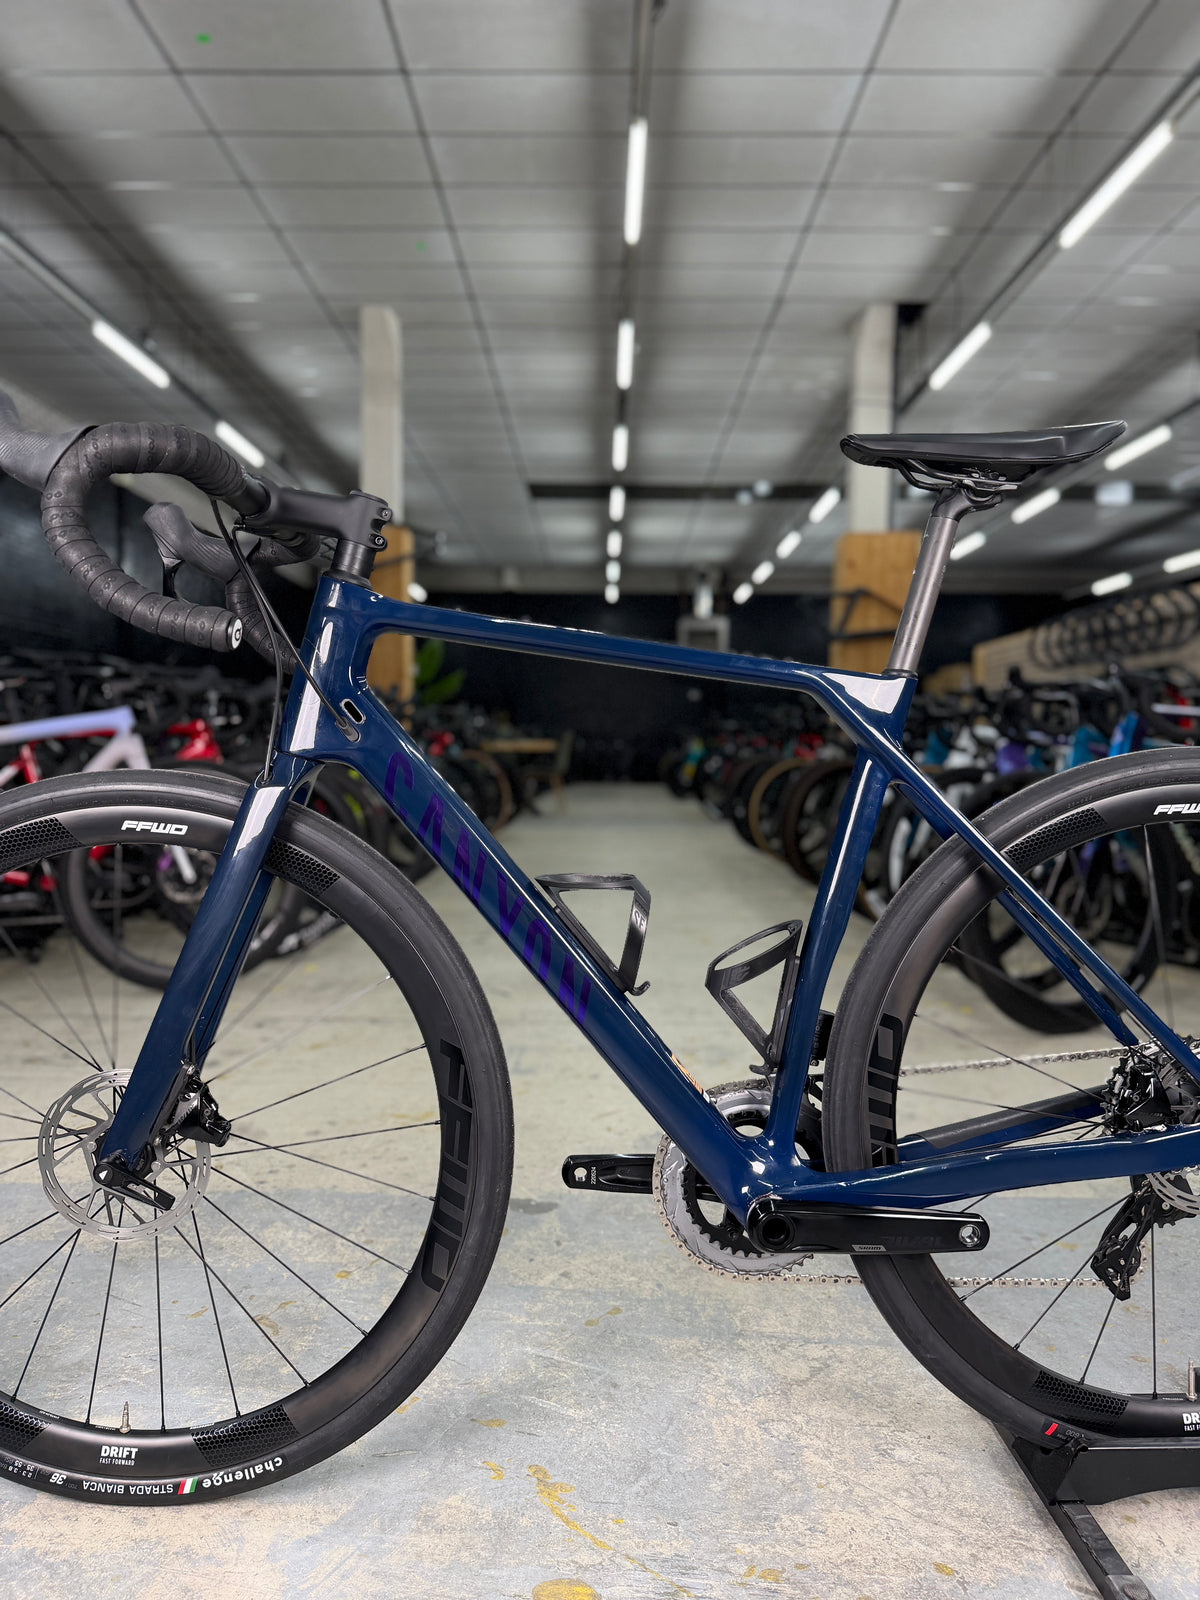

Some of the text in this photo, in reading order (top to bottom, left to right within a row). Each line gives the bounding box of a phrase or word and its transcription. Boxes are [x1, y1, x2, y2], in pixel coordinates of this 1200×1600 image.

[121, 820, 189, 835] FFWD
[384, 751, 592, 1025] CANYON
[421, 1039, 473, 1293] FFWD
[1182, 1412, 1200, 1424] DR
[100, 1445, 138, 1459] DRIFT
[49, 1472, 67, 1485] 36
[202, 1457, 283, 1488] challenge
[82, 1480, 125, 1494] BIANCA
[129, 1483, 174, 1495] STRADA
